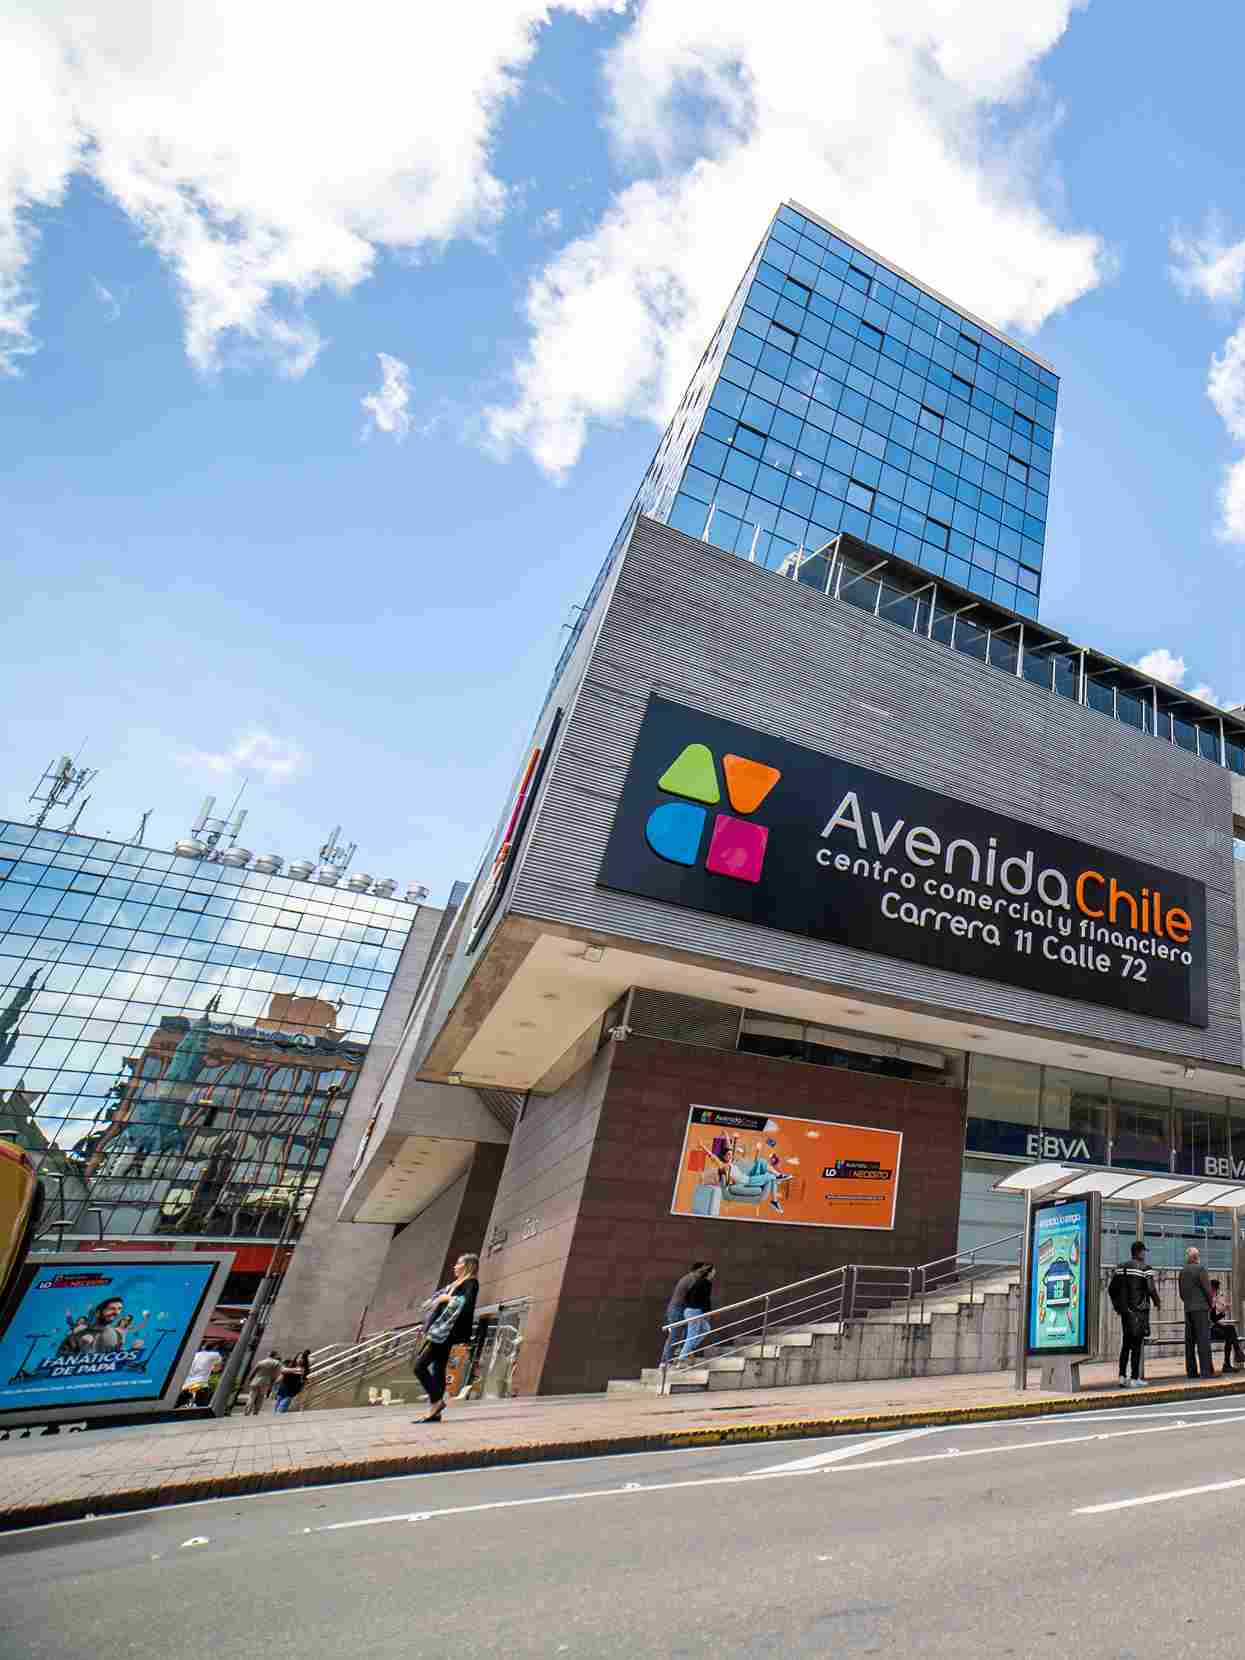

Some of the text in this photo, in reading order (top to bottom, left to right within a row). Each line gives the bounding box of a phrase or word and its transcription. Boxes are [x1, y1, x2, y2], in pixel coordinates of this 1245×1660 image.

[816, 848, 1193, 966] centro comercial y financiero
[880, 891, 1148, 983] Carrera 11 Calle 72
[1026, 1133, 1090, 1159] BBVA
[51, 1365, 76, 1377] DE
